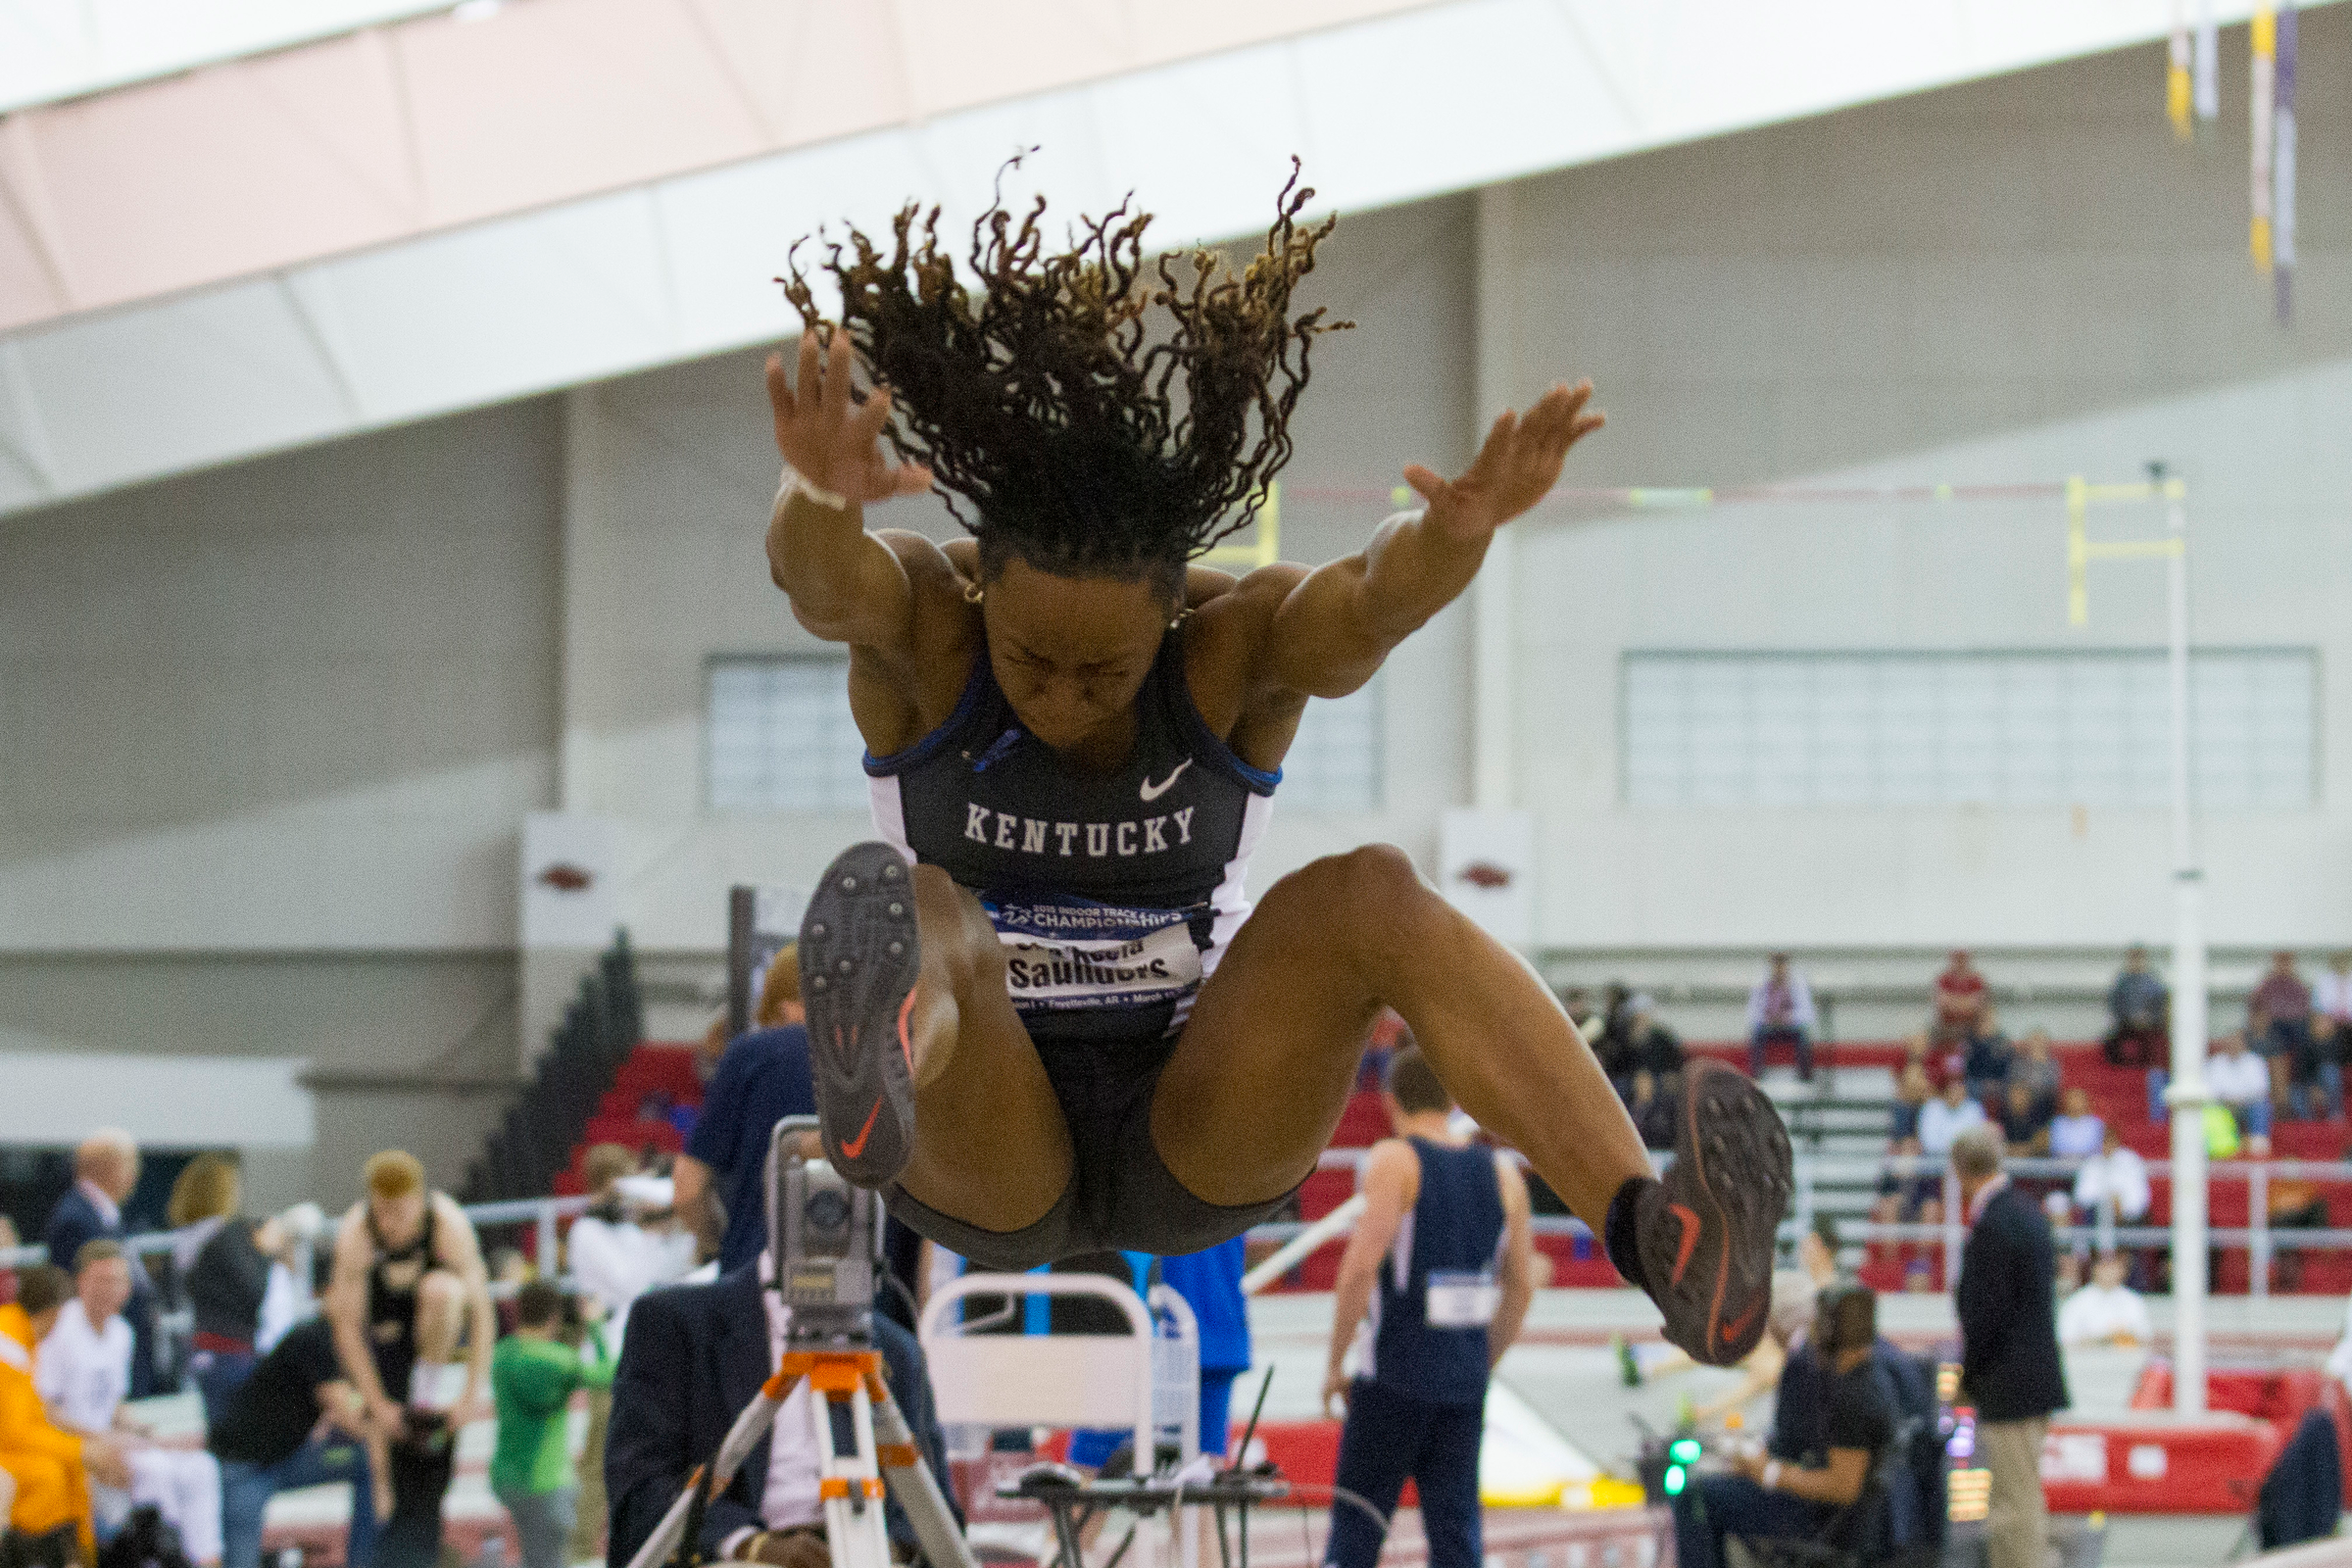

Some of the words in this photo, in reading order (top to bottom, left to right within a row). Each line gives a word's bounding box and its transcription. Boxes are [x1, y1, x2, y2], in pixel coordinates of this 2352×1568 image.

[963, 802, 1195, 858] KENTUCKY
[1058, 906, 1101, 917] INDOOR
[1102, 907, 1137, 918] TRACK
